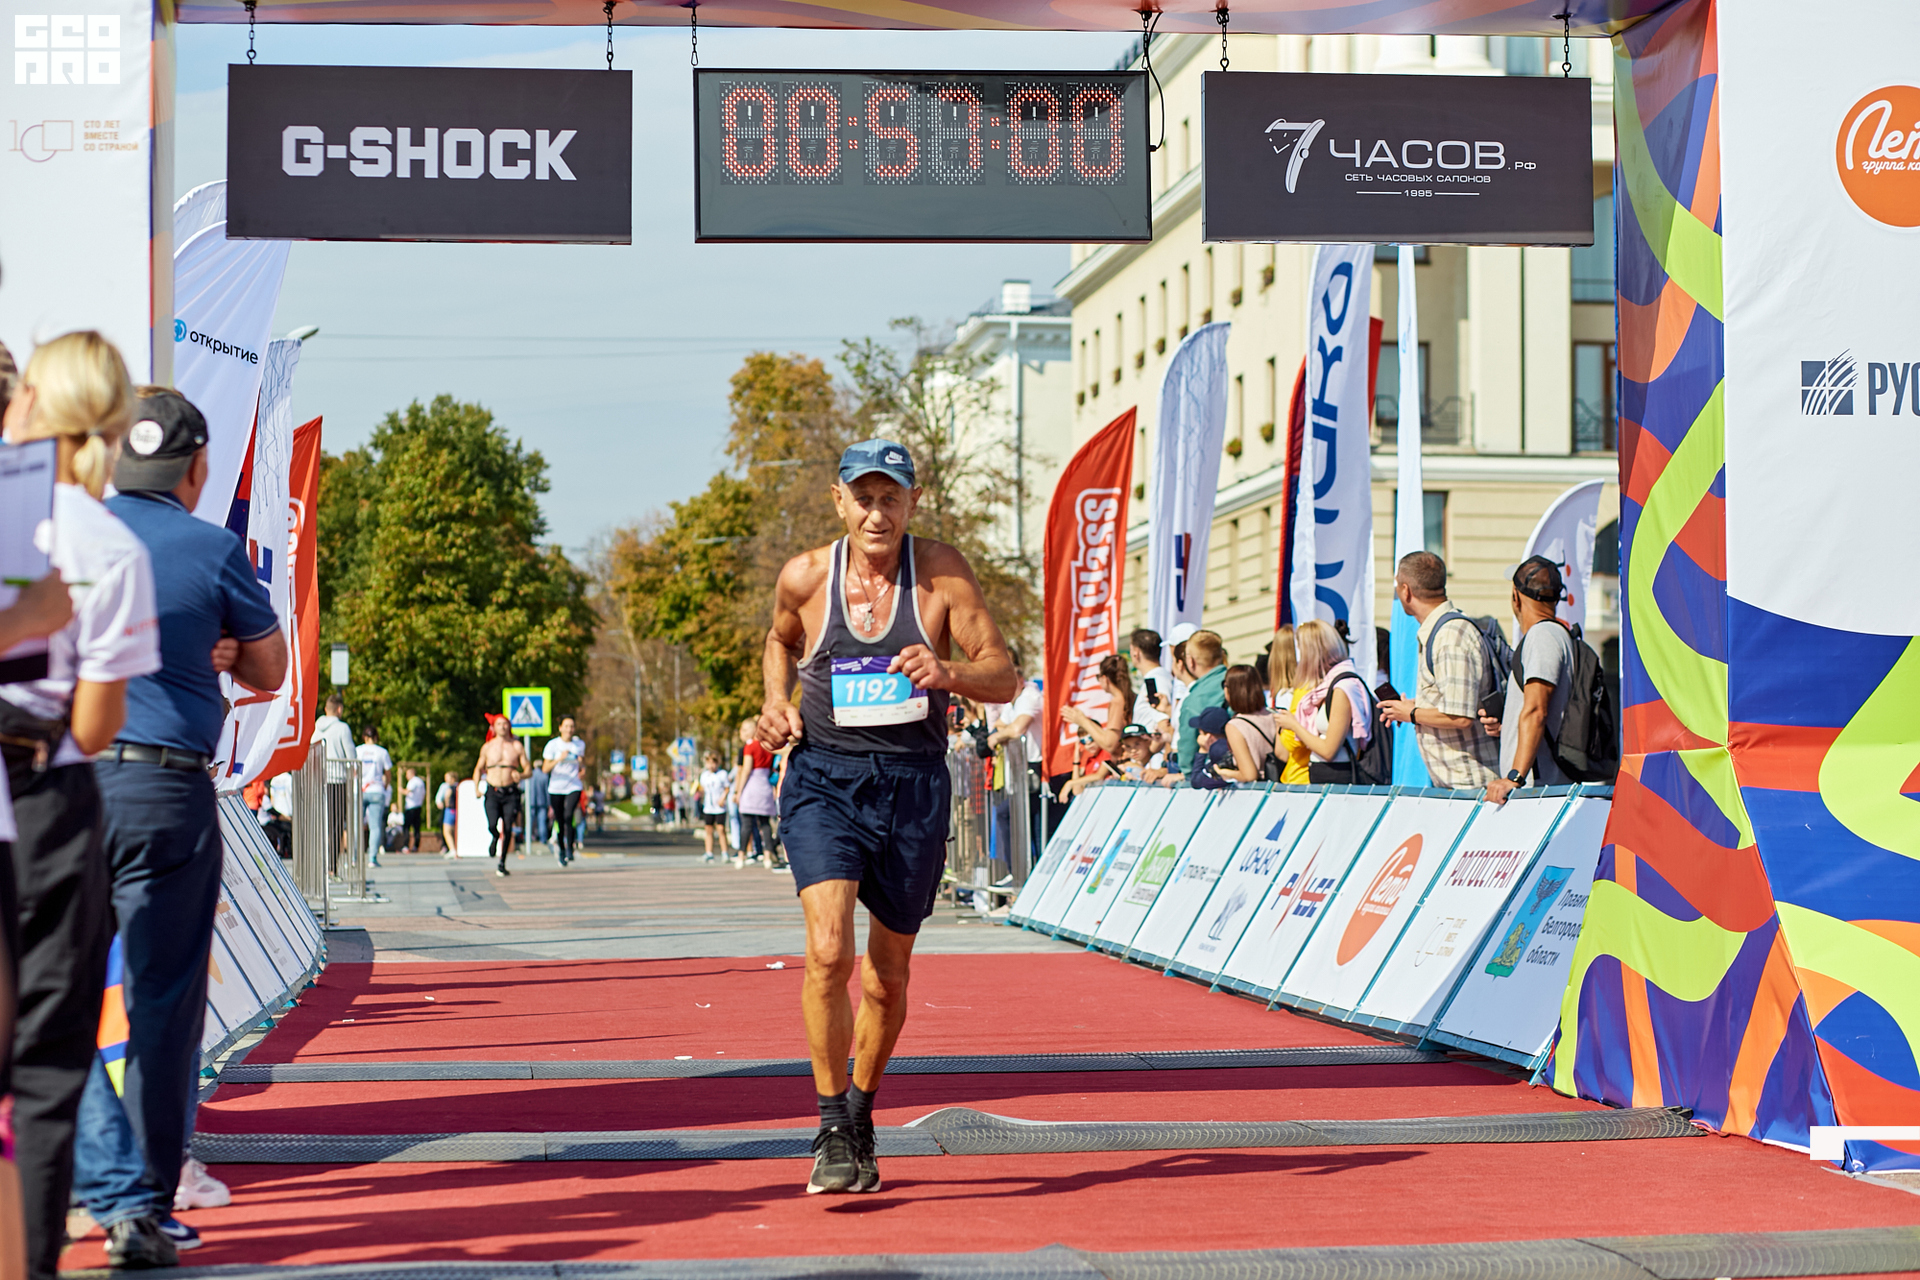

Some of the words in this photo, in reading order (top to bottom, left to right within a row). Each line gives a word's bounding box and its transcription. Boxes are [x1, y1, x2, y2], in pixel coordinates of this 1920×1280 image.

[83, 119, 102, 129] СТО
[104, 119, 121, 129] ЛЕТ
[83, 131, 119, 141] ВМЕСТЕ
[83, 142, 96, 152] СО
[98, 141, 139, 152] СТРАНОЙ
[281, 124, 577, 181] G-SHOCK
[1861, 160, 1906, 175] группа
[1345, 173, 1374, 182] СЕТЬ
[1376, 174, 1433, 183] ЧАСОВЫХ
[1436, 175, 1491, 184] САЛОНОВ
[1403, 189, 1433, 198] 1995
[189, 330, 259, 365] открытие
[1076, 497, 1119, 609] Class
[845, 677, 899, 704] 1192
[1444, 849, 1528, 889] РОСГОССТРАХ
[1525, 944, 1561, 966] области
